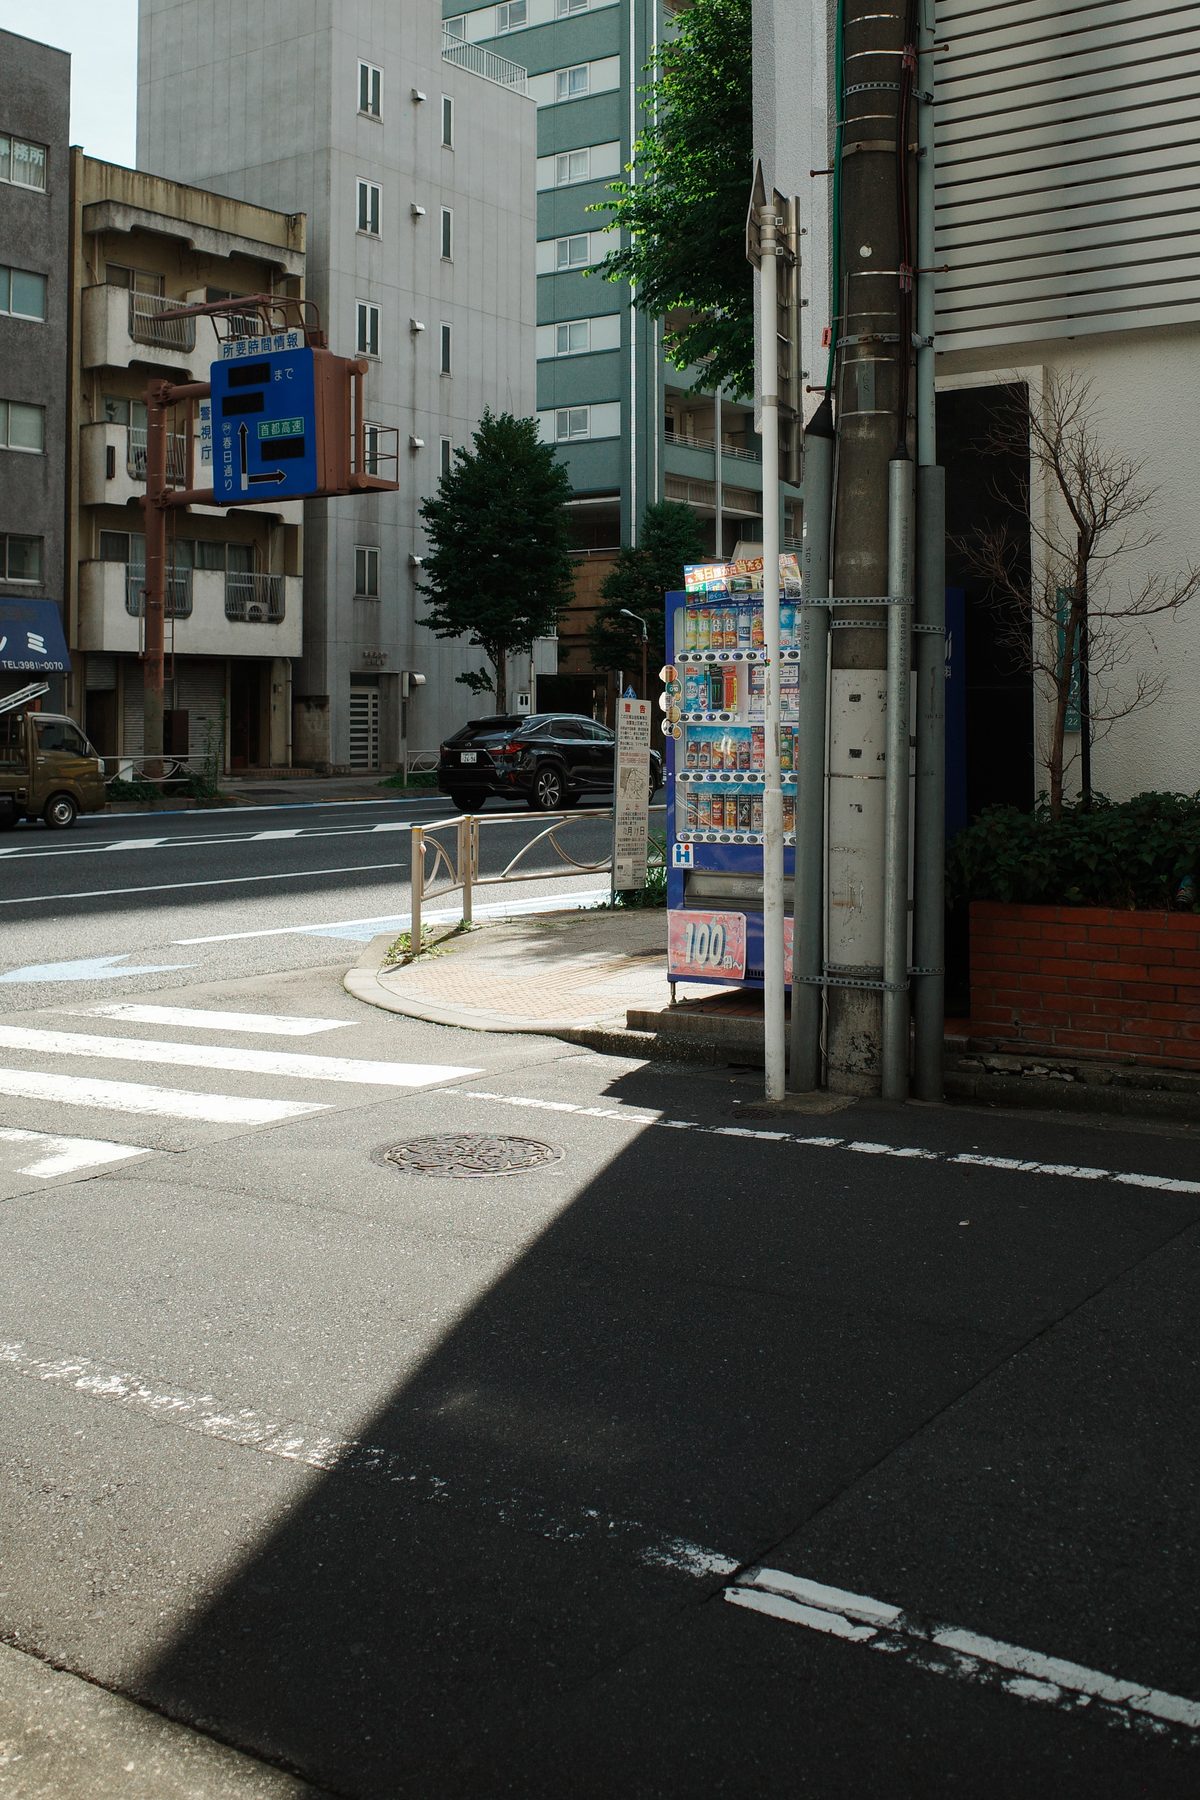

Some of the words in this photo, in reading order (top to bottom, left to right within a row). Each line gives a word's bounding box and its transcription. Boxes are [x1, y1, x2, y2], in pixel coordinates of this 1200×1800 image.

[223, 332, 299, 359] 所要時間情報
[273, 367, 294, 382] まで
[200, 406, 212, 460] 警視庁
[260, 419, 302, 437] 首都高速
[223, 436, 233, 491] 春日通り
